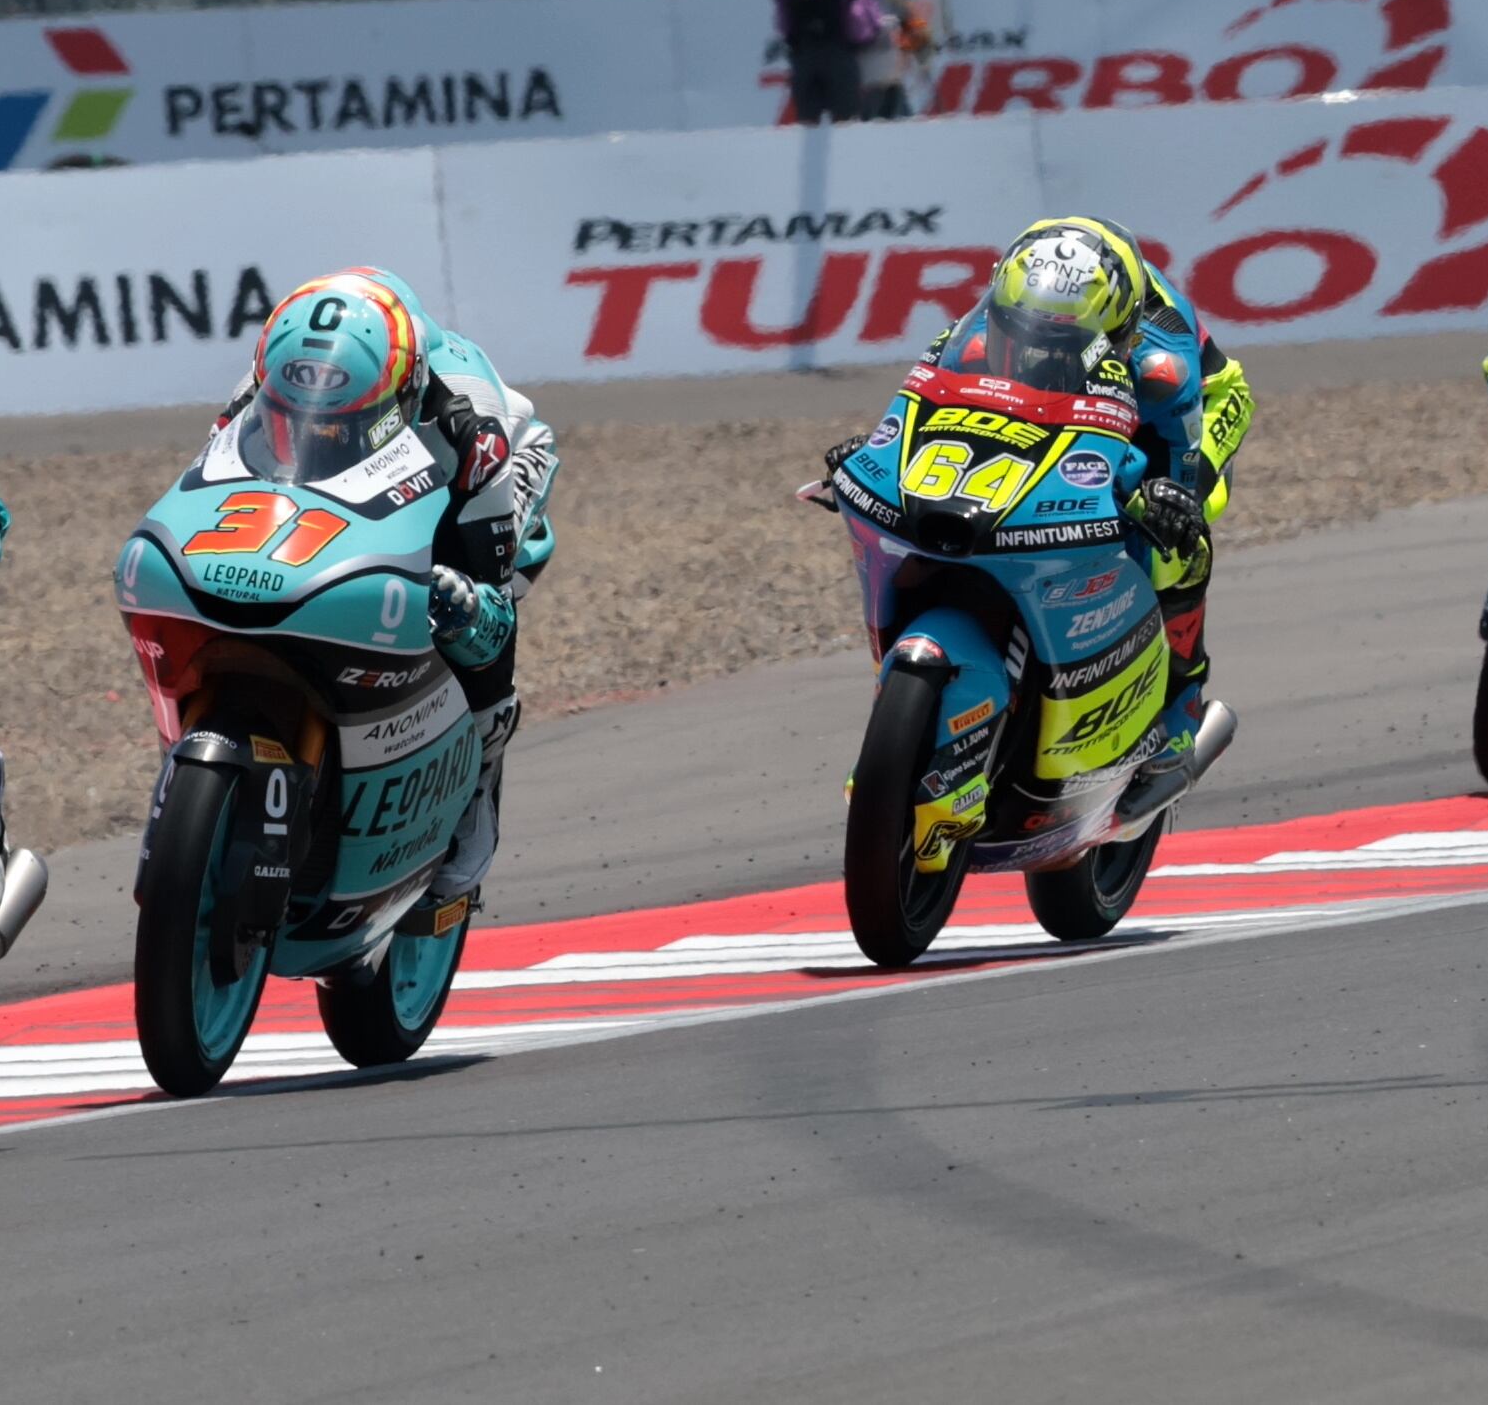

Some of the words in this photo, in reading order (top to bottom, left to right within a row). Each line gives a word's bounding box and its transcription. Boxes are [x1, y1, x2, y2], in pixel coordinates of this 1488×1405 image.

[163, 65, 564, 139] PERTAMINA
[574, 206, 942, 254] PERTAMAX
[1027, 273, 1081, 297] GUP
[1032, 258, 1086, 283] PONT
[567, 228, 1376, 359] TURO
[293, 364, 343, 390] KYT
[1072, 400, 1133, 424] LS2
[1073, 413, 1132, 434] HELMETS
[364, 443, 410, 478] ANONIMO
[899, 439, 1035, 513] 64
[1065, 460, 1108, 472] FACE
[387, 470, 434, 506] DOVIT
[833, 466, 874, 512] INFINITUM
[870, 500, 901, 528] FEST
[182, 491, 351, 568] 31
[996, 525, 1084, 547] INFINITUM
[1085, 519, 1120, 539] FEST
[203, 563, 285, 592] LEOPARD
[215, 587, 261, 602] NATURAL
[1050, 633, 1136, 690] INFINITUM
[363, 688, 450, 741] ANONIMO
[951, 701, 990, 732] PIRELLI
[384, 730, 426, 755] watches
[342, 726, 477, 838] LEOPARD
